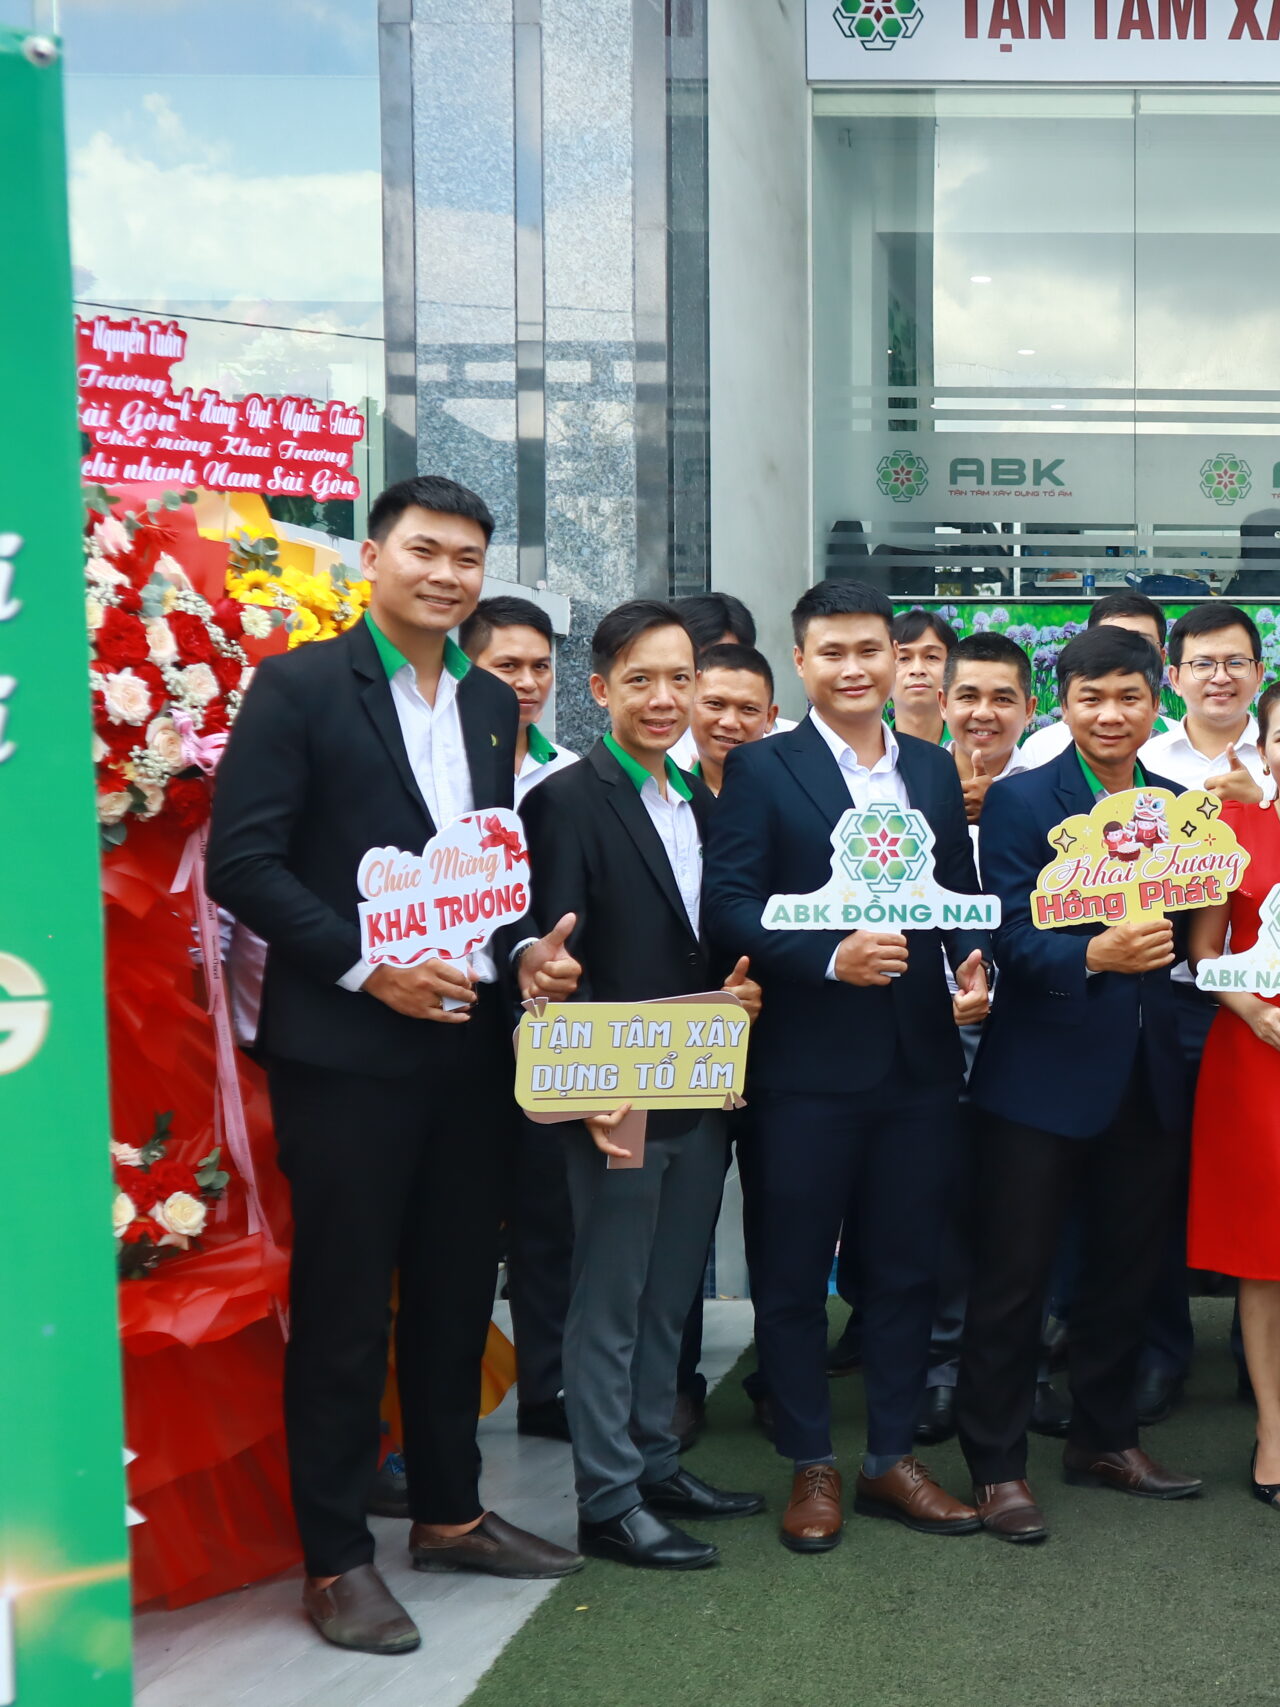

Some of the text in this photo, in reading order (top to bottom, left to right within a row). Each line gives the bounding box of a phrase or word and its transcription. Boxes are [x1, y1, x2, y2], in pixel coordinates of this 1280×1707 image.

[77, 364, 167, 398] Trương
[78, 396, 111, 427] ài
[118, 400, 177, 436] Gòn
[217, 435, 271, 458] Khai
[278, 440, 349, 467] Trương
[81, 453, 357, 500] chi nhánh Nam Sài Gòn
[949, 458, 1066, 486] ABK
[364, 847, 500, 897] Chúc Mừng
[1042, 842, 1244, 893] Khai Trương
[366, 882, 527, 948] KHAI TRƯƠNG
[770, 894, 993, 924] ABK ĐỒNG NAI
[1036, 873, 1223, 925] Hồng Phát
[1201, 968, 1248, 988] ABK
[527, 1015, 747, 1054] TẬN TÂM XÂY
[531, 1052, 734, 1098] DỰNG TỔ ẤM
